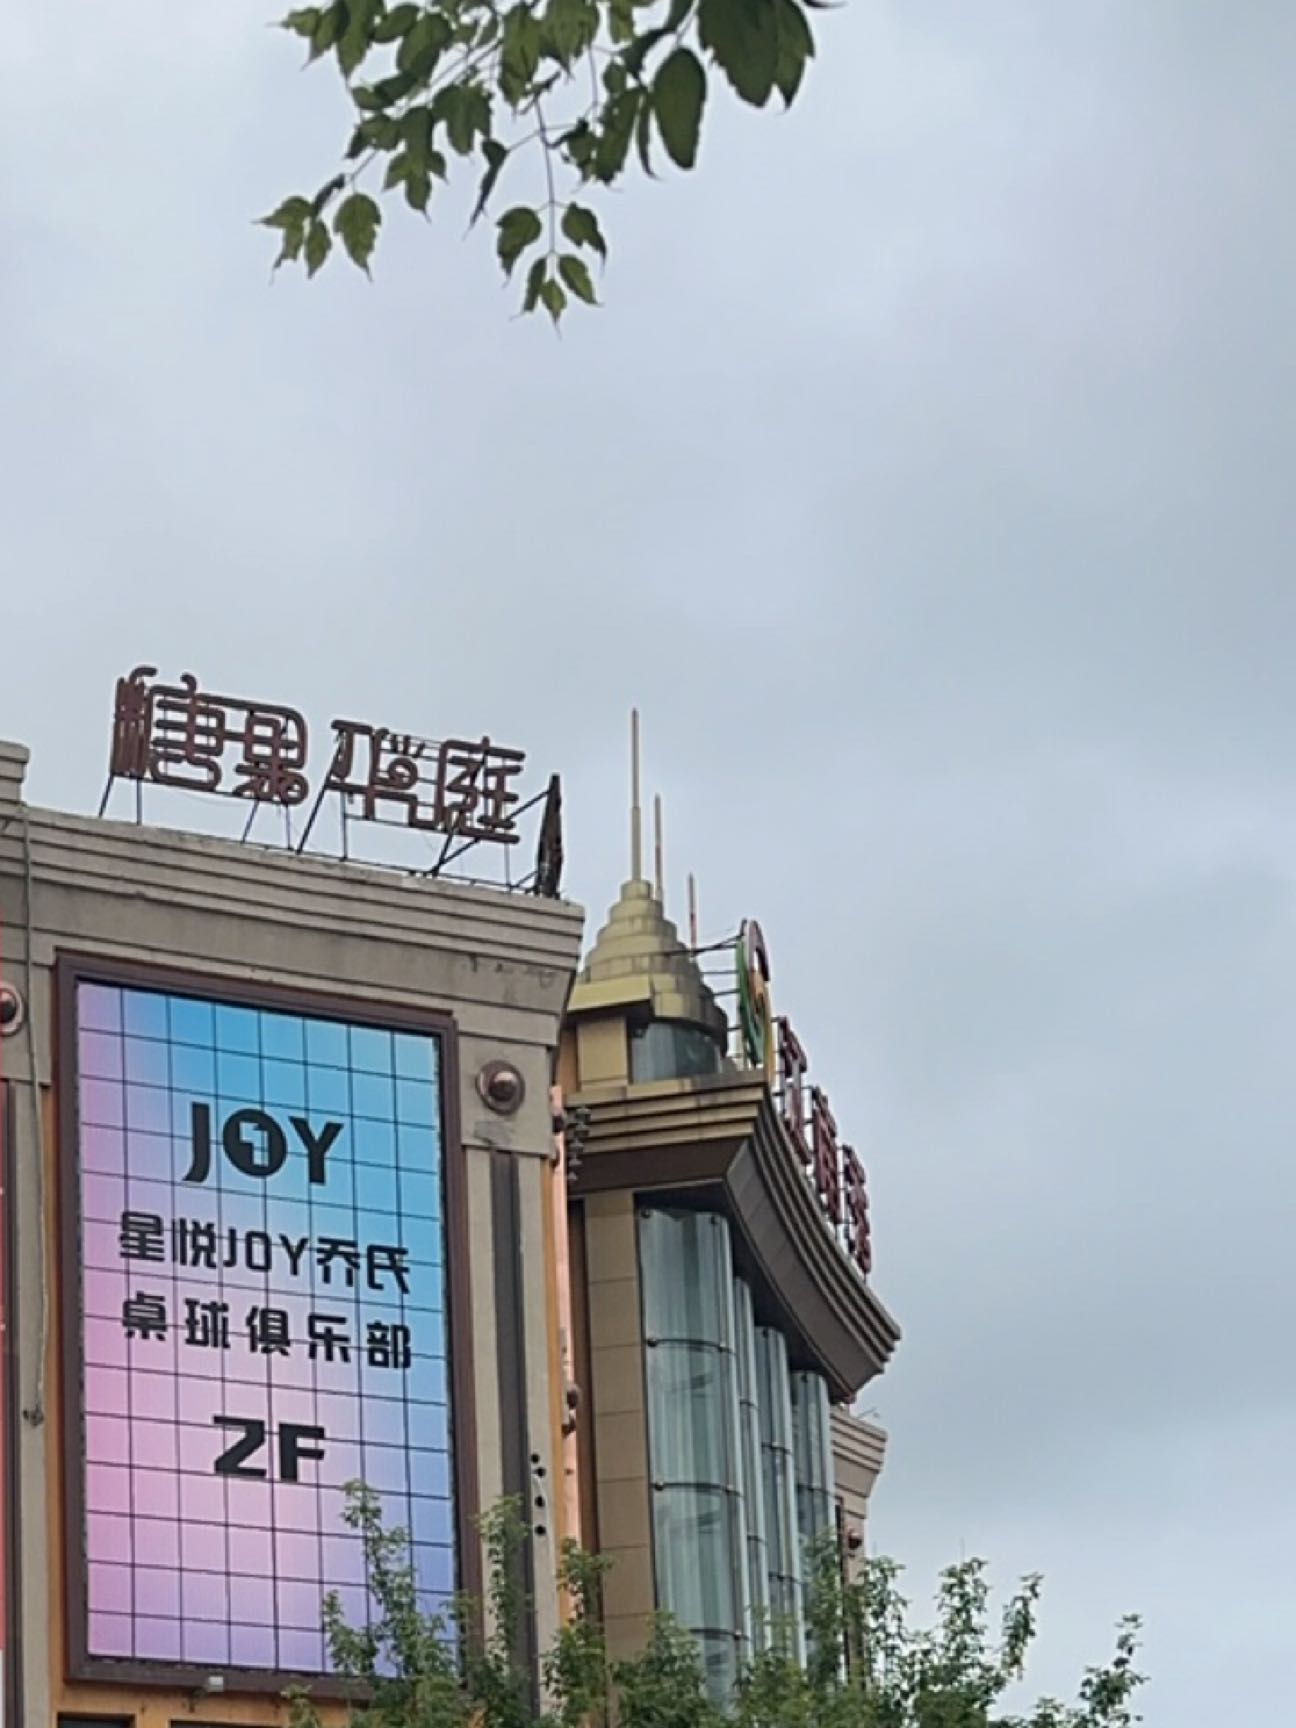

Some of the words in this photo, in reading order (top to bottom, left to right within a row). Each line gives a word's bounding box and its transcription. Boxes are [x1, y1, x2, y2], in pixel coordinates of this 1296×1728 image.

[183, 1101, 343, 1185] JOY
[121, 1291, 412, 1370] 桌球俱乐部
